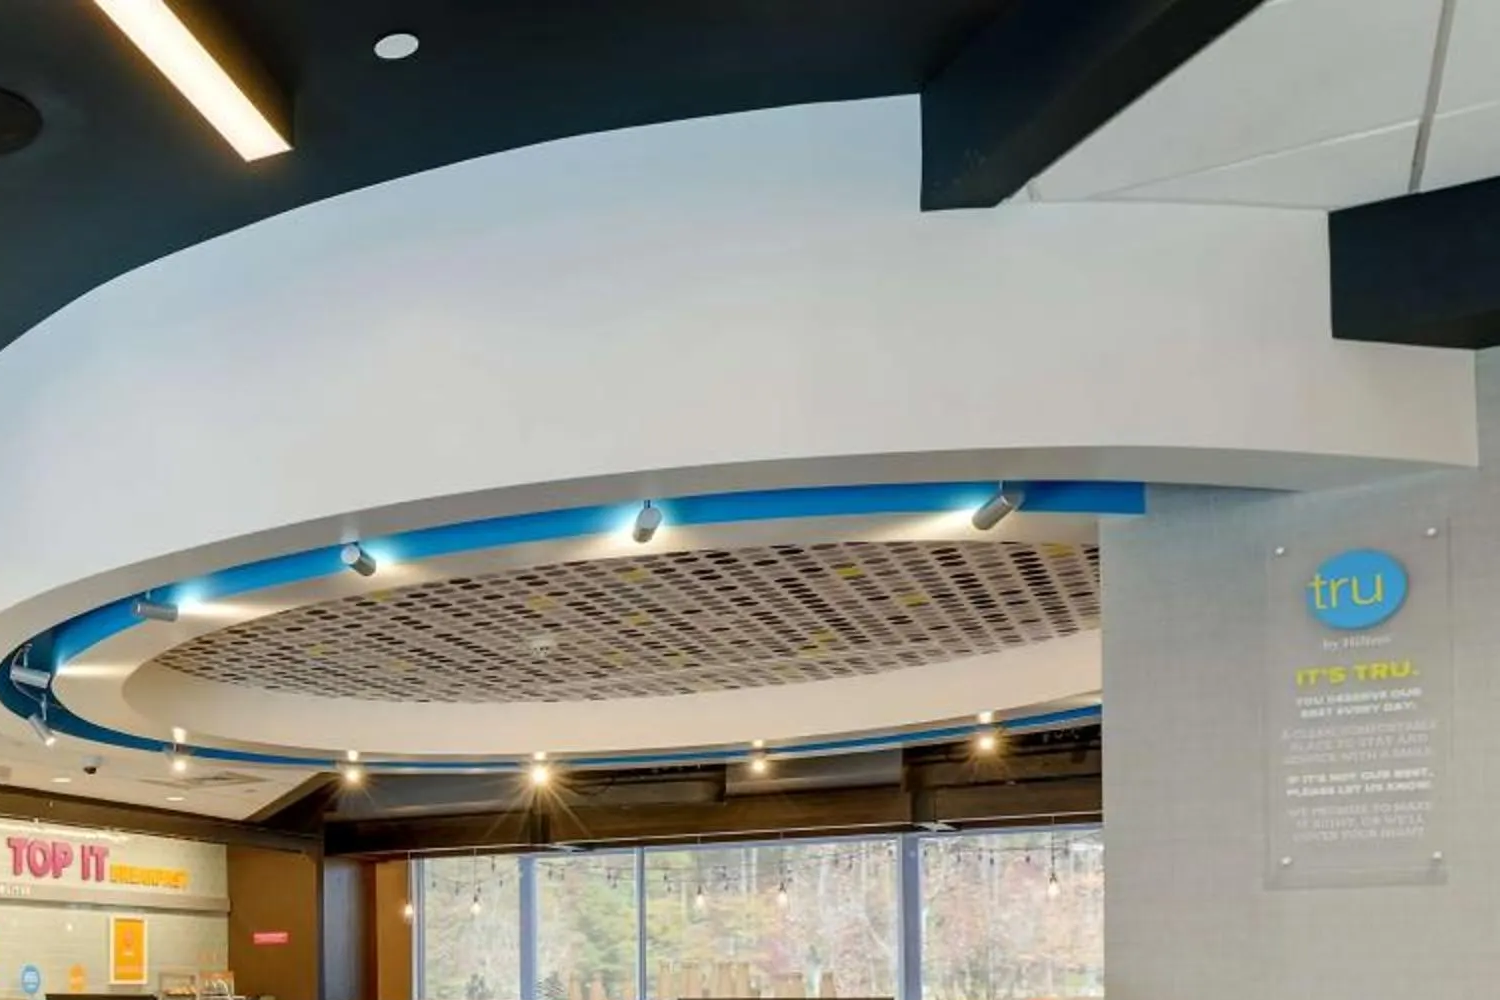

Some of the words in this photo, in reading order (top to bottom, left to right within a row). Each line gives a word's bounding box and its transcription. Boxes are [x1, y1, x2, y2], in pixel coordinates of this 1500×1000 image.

[1306, 573, 1384, 610] tru
[1296, 666, 1347, 686] IT'S
[1352, 659, 1421, 681] TRU.
[6, 836, 74, 879] TOP
[80, 844, 110, 882] IT
